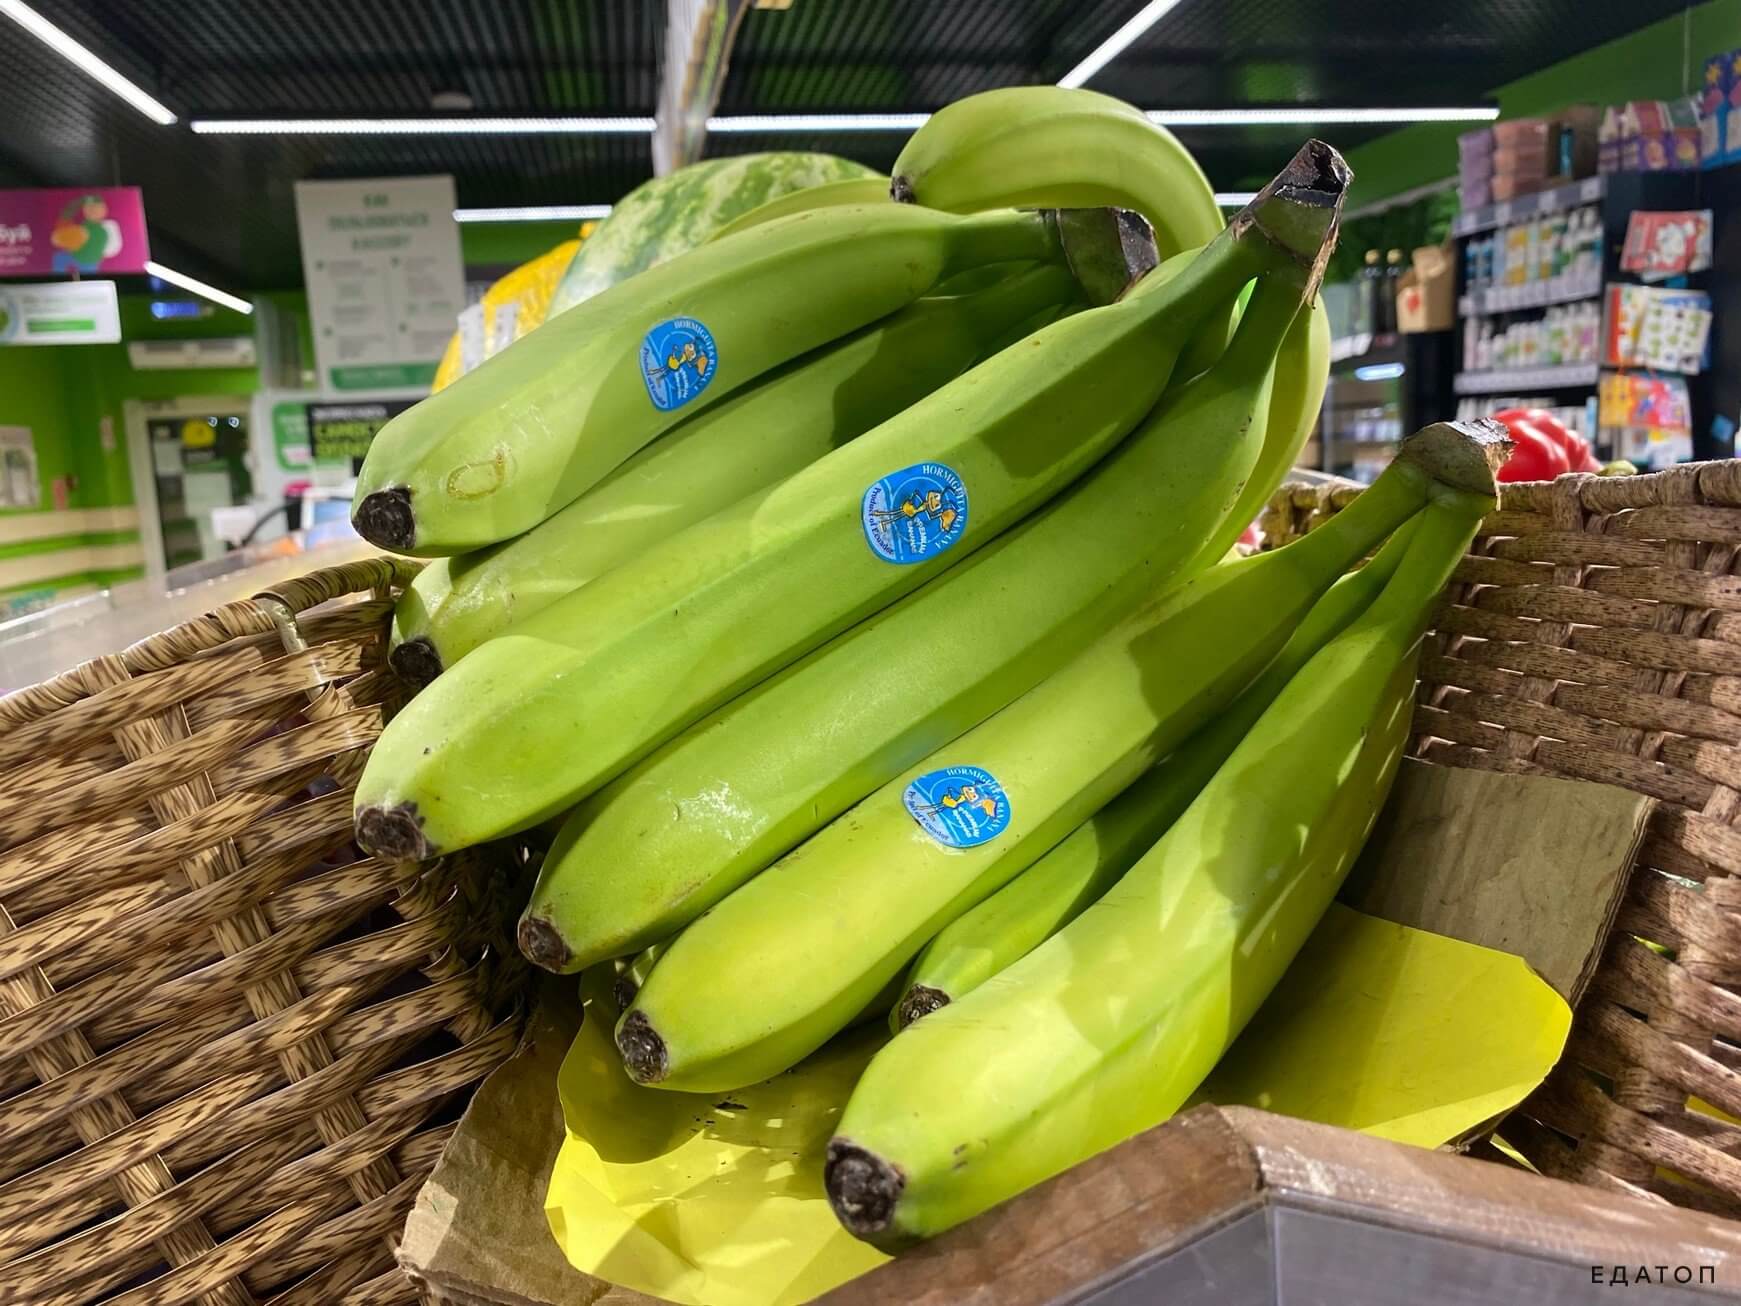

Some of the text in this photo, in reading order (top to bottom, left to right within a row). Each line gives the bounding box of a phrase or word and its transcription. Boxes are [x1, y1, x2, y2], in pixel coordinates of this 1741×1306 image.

[867, 487, 882, 515] Product
[870, 527, 894, 555] Ecuador
[934, 514, 964, 550] BANANA
